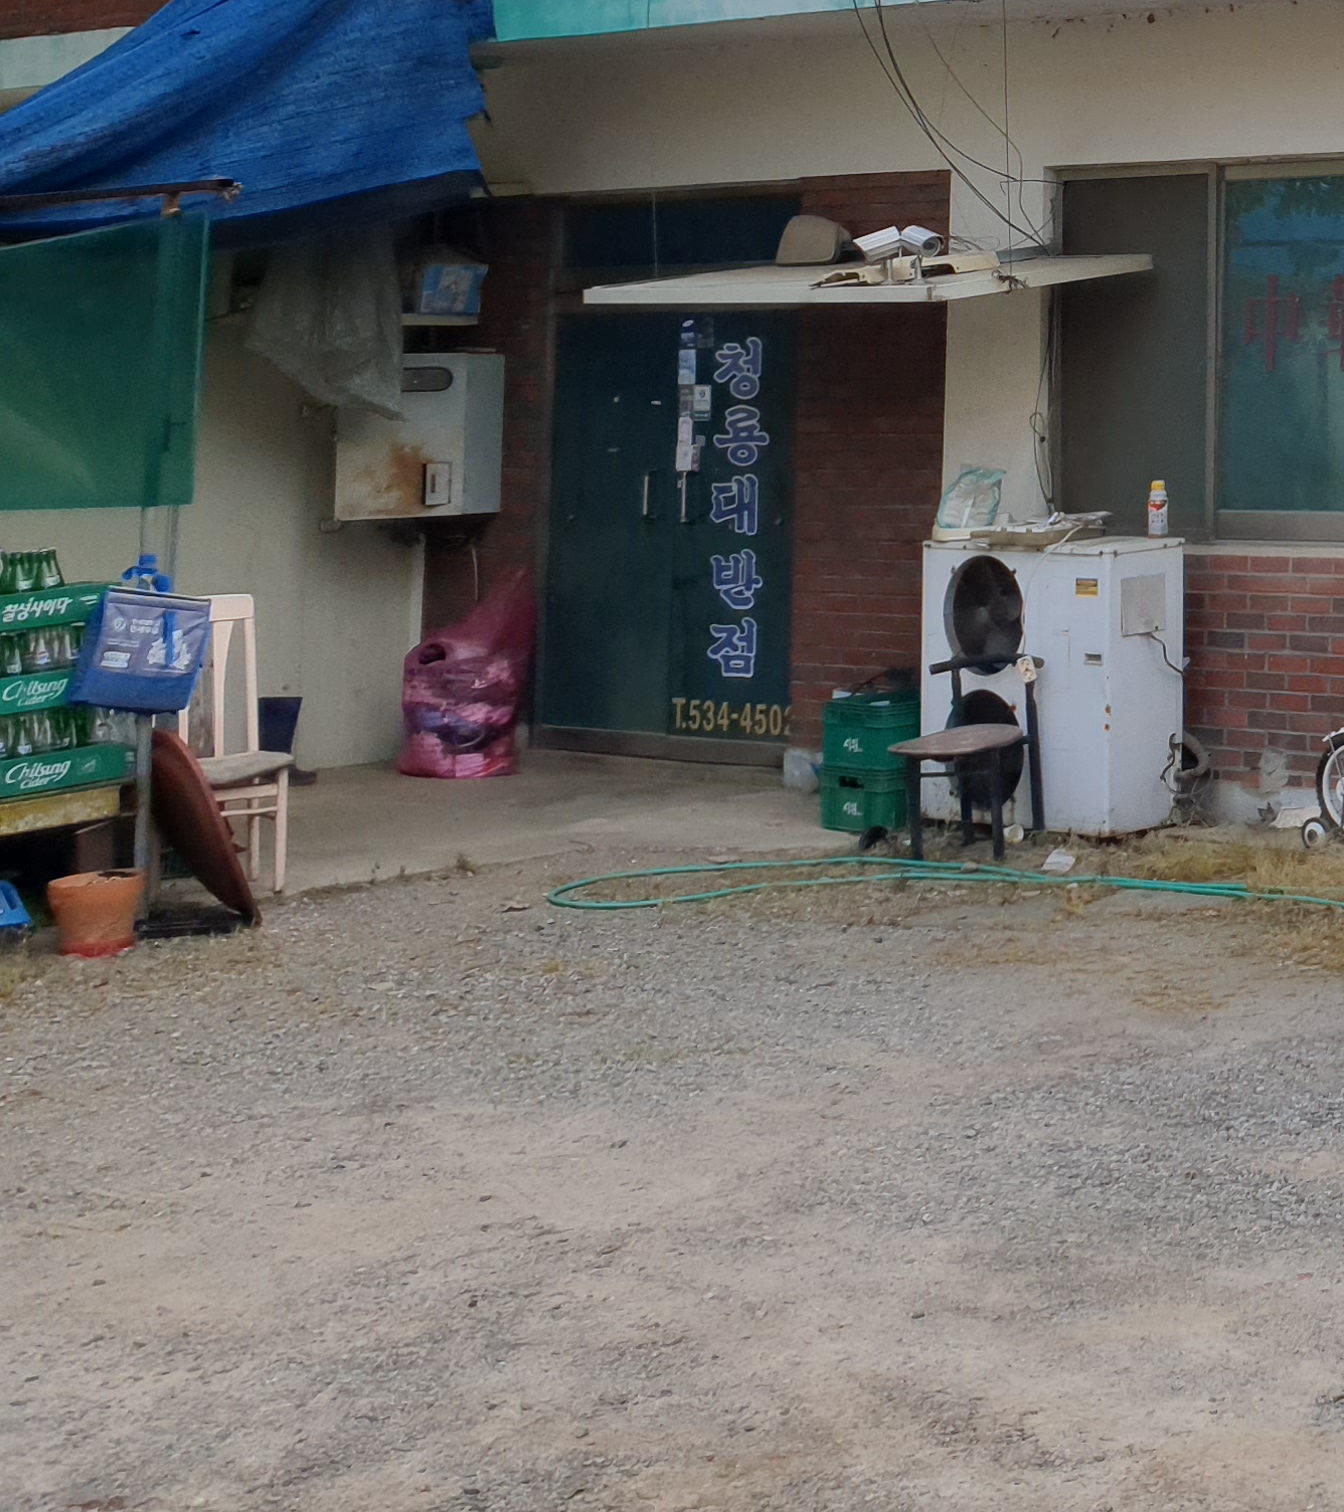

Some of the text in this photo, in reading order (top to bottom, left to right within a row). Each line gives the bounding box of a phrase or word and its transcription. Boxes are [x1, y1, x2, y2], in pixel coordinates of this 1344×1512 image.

[708, 336, 769, 679] 청룡대반점
[2, 596, 74, 623] 칠성사이다
[5, 760, 72, 784] Chilsung
[20, 774, 58, 789] Cider
